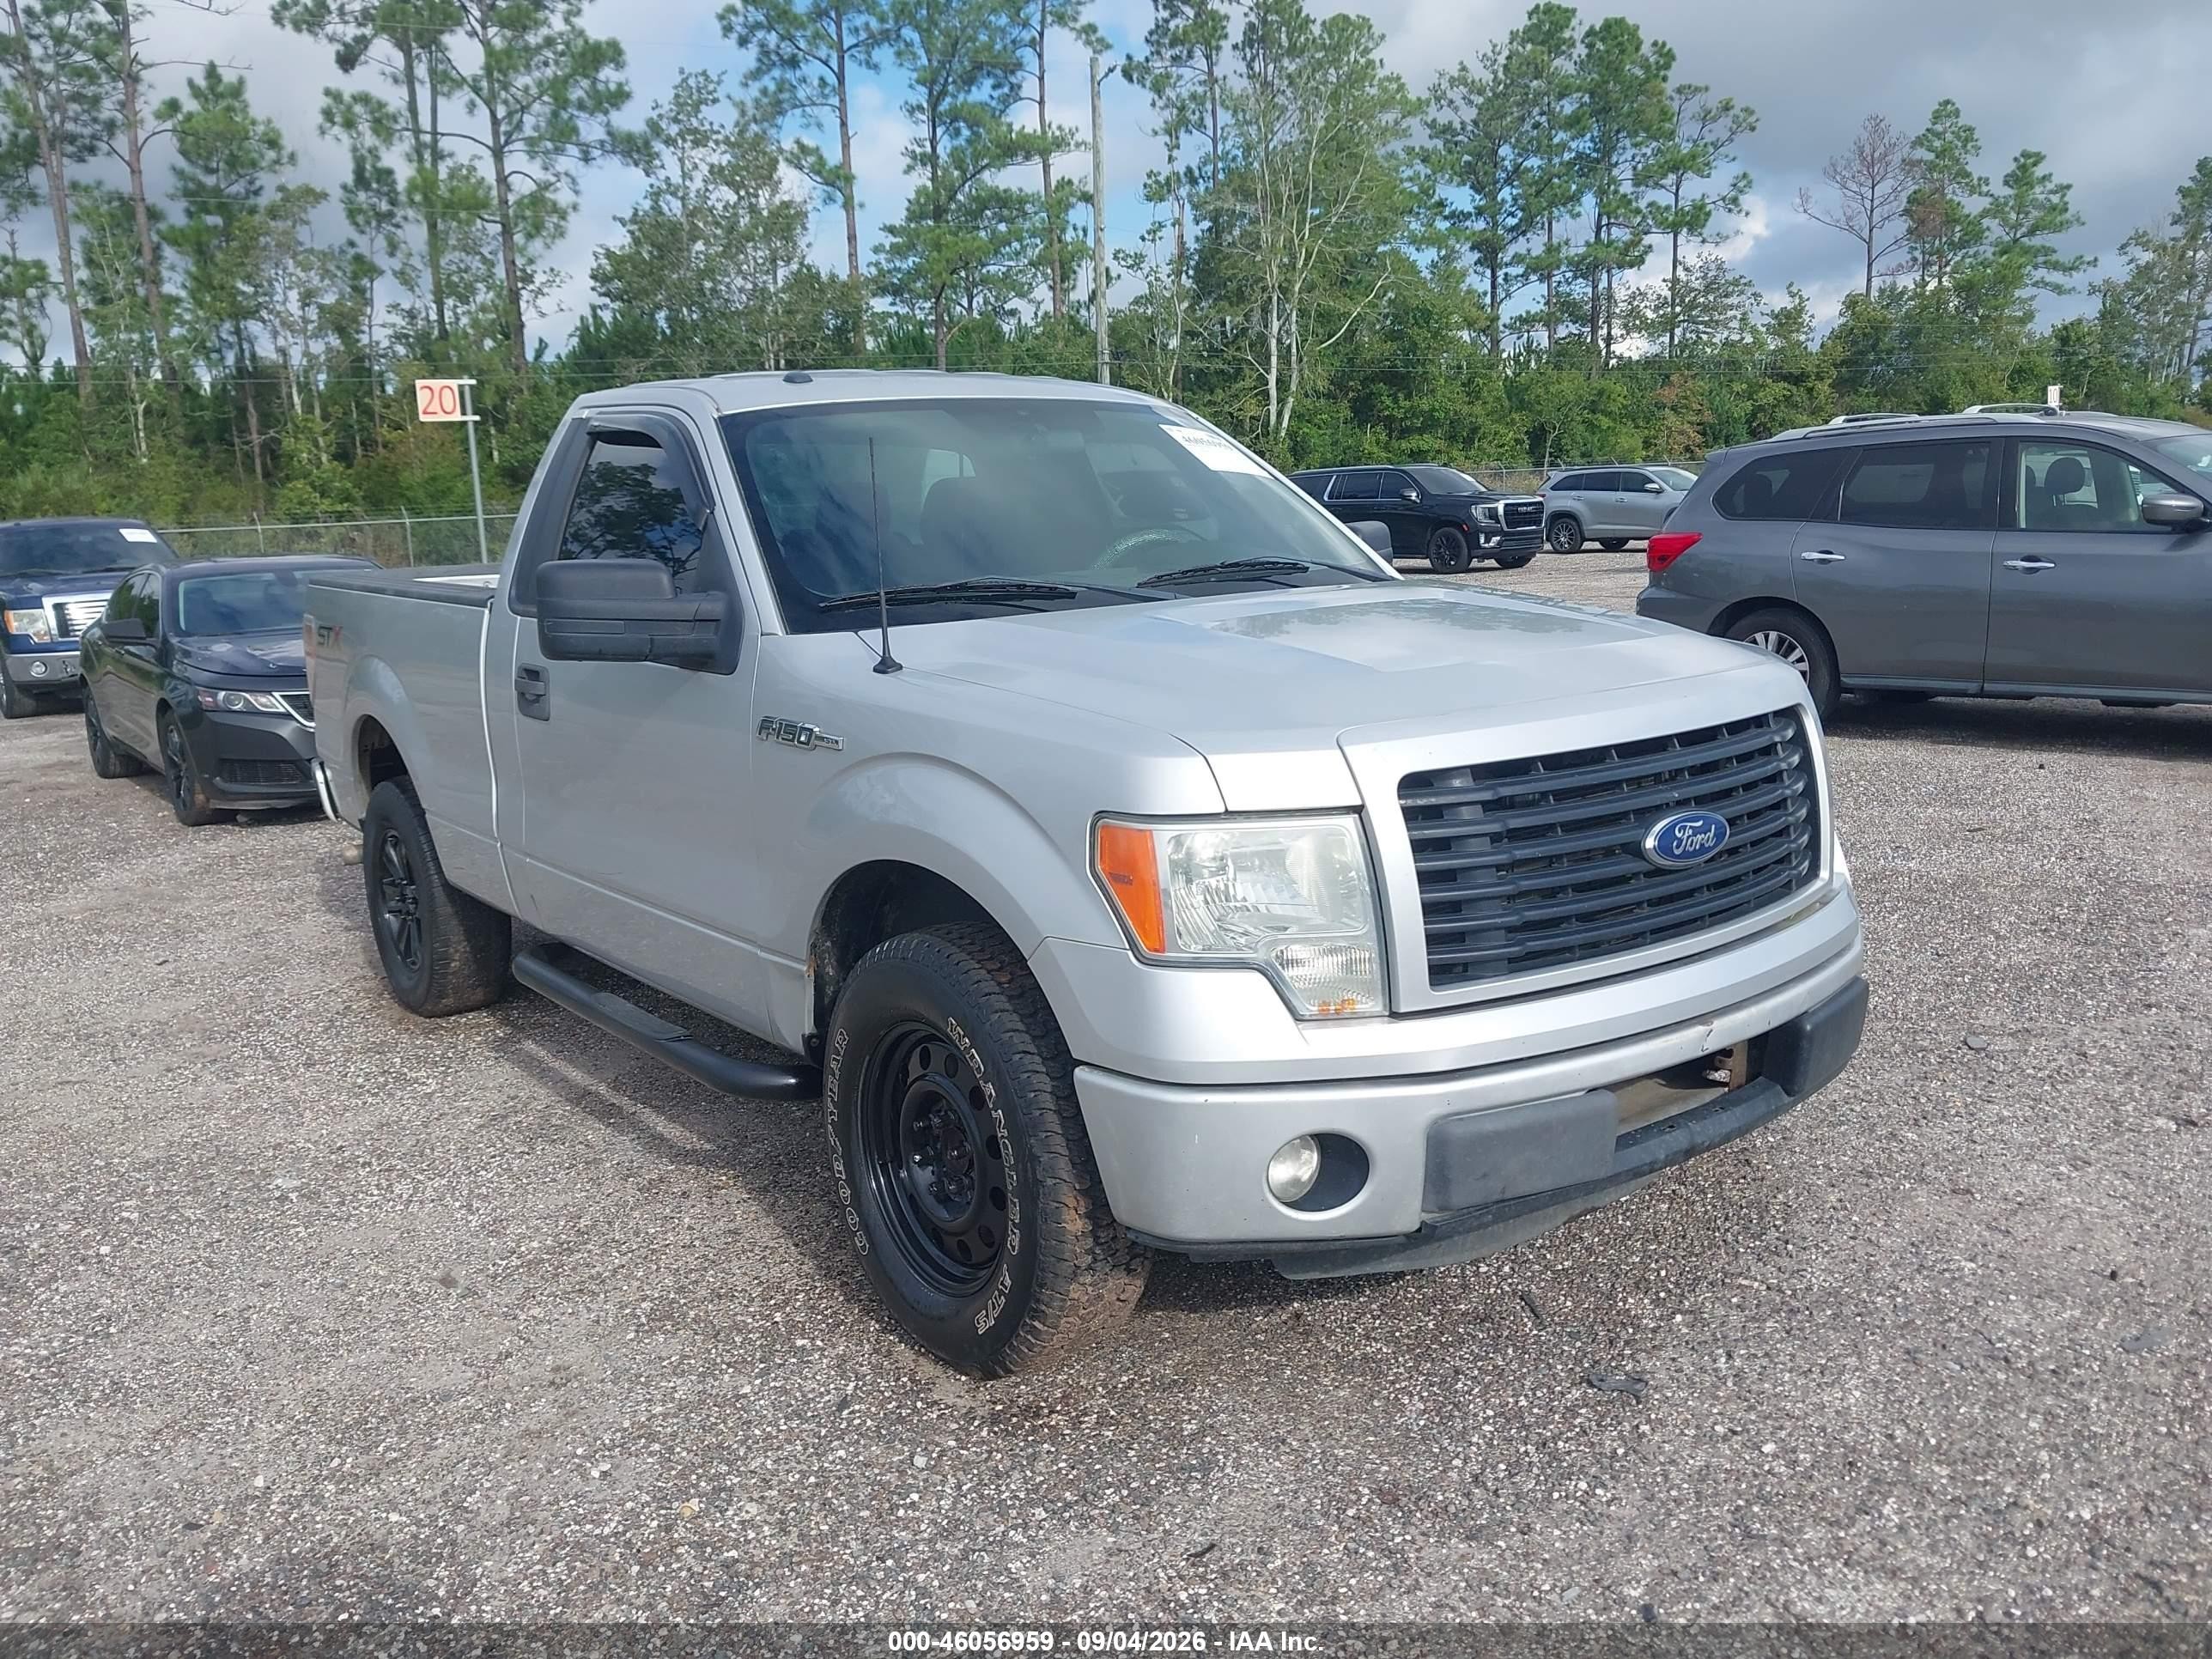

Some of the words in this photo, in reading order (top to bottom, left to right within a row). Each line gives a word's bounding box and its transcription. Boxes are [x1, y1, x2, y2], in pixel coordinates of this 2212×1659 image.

[419, 385, 457, 415] 20
[2049, 387, 2058, 404] 10
[317, 624, 343, 651] STX
[1672, 819, 1717, 855] Ford
[827, 1029, 869, 1255] GOODYEAR
[947, 1017, 1020, 1255] WRANGLER
[974, 1264, 1011, 1335] AT/S
